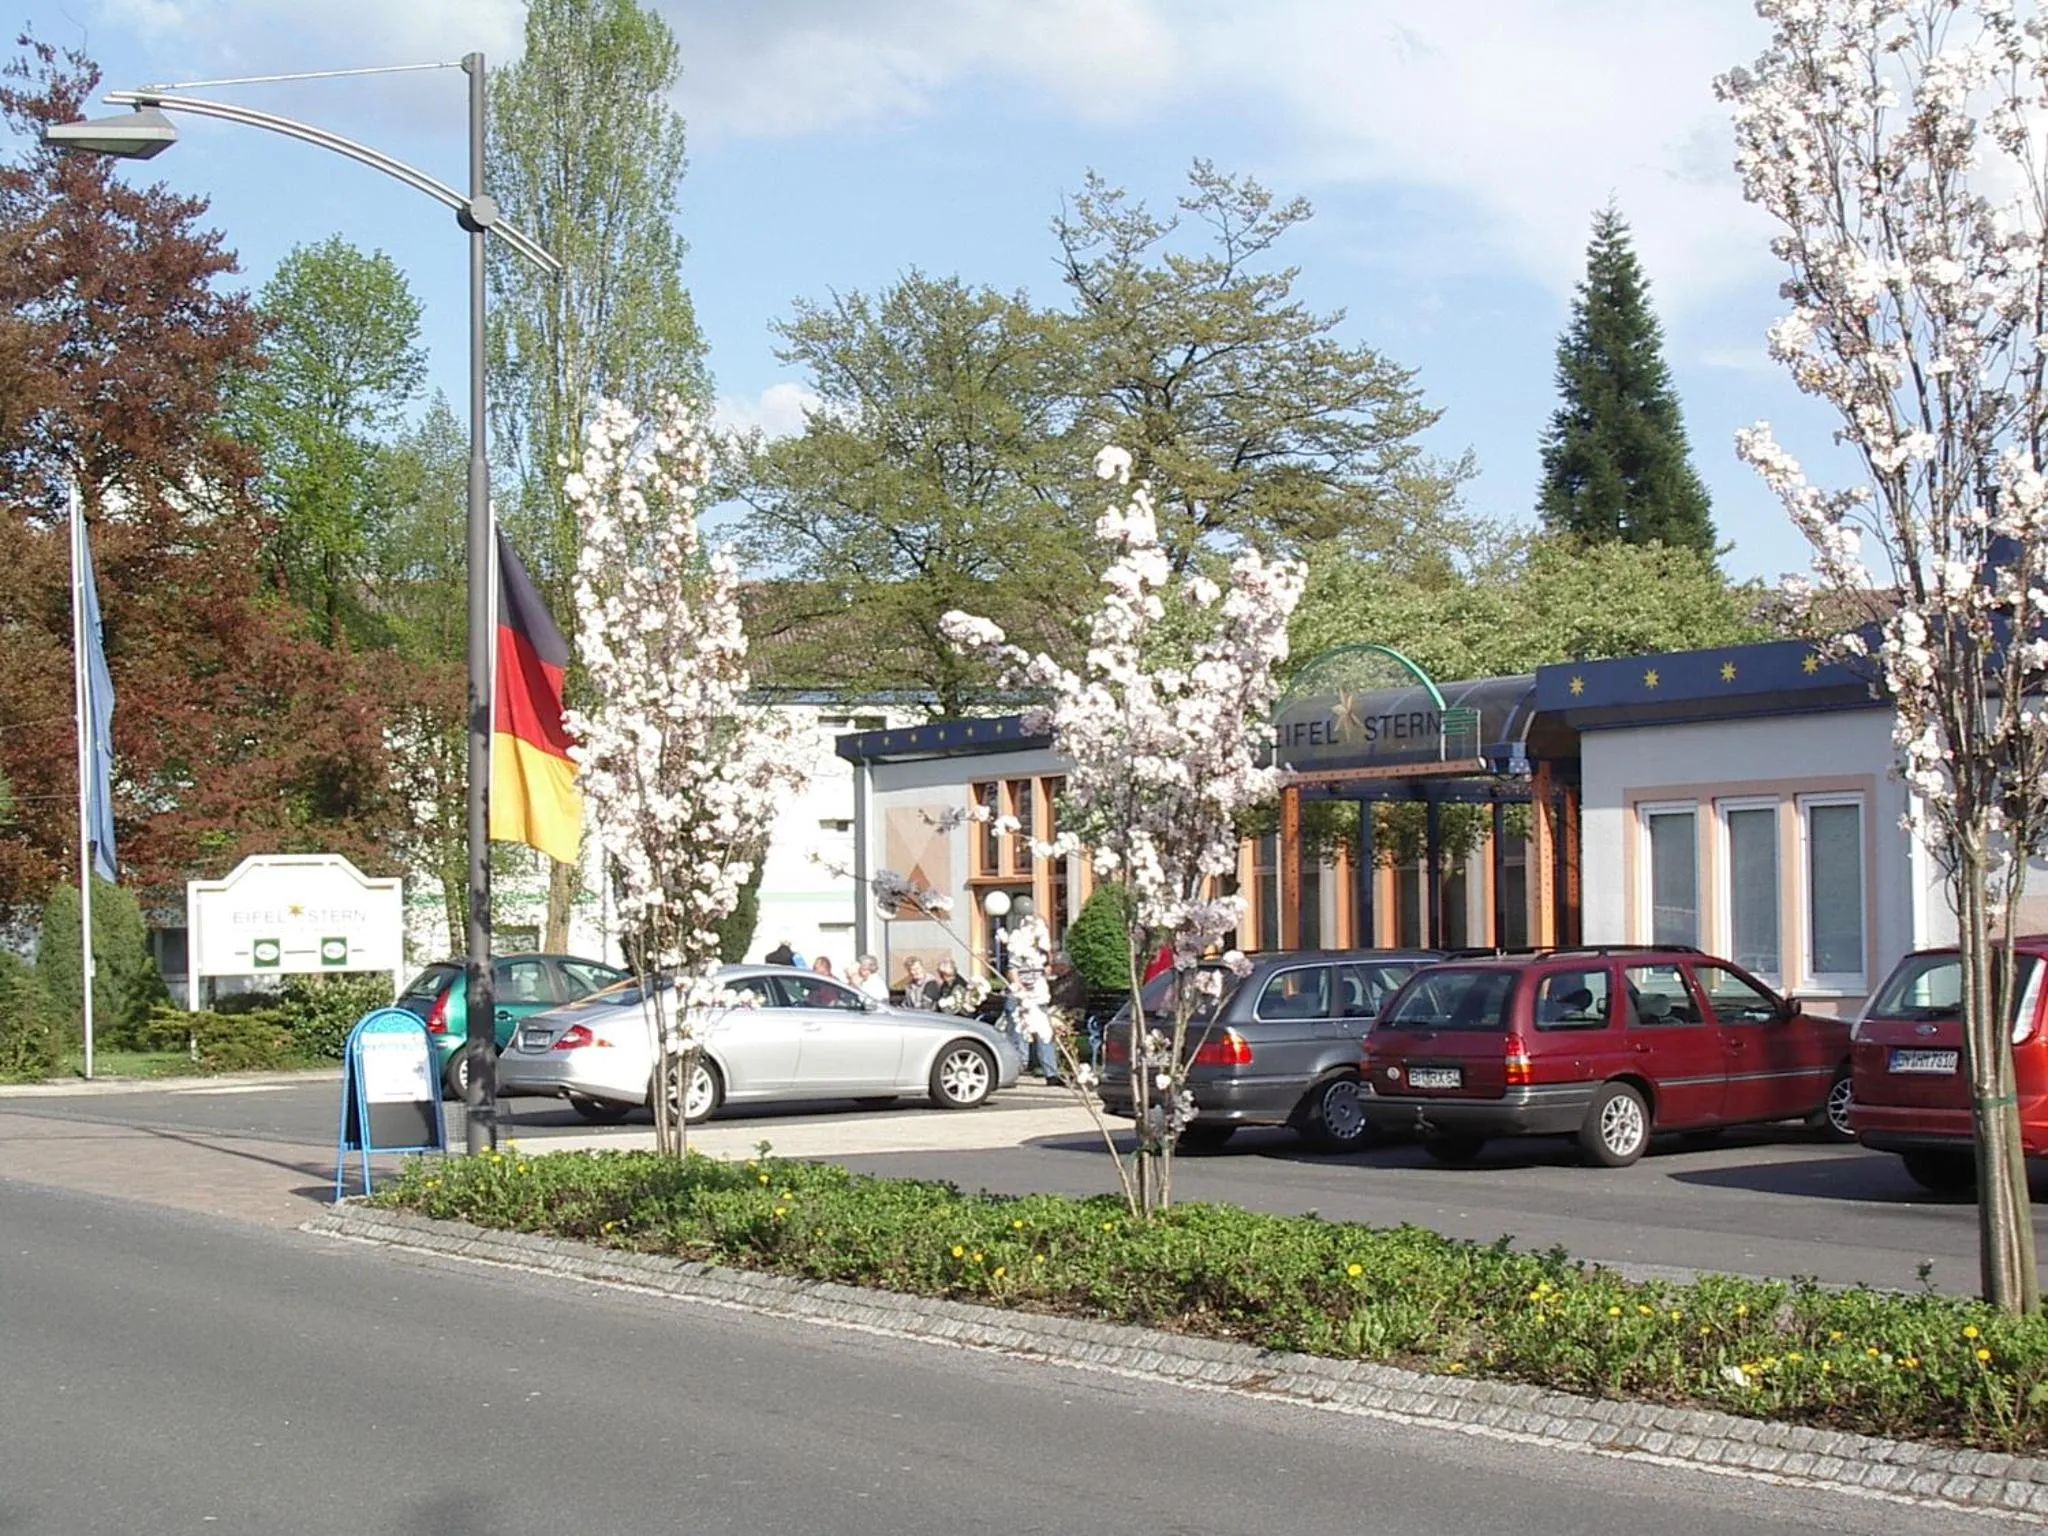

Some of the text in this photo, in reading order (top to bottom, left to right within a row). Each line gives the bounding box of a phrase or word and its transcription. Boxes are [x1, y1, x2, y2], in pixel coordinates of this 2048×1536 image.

[1271, 711, 1442, 749] EIFEL STERN
[232, 907, 366, 925] EIFEL STERN
